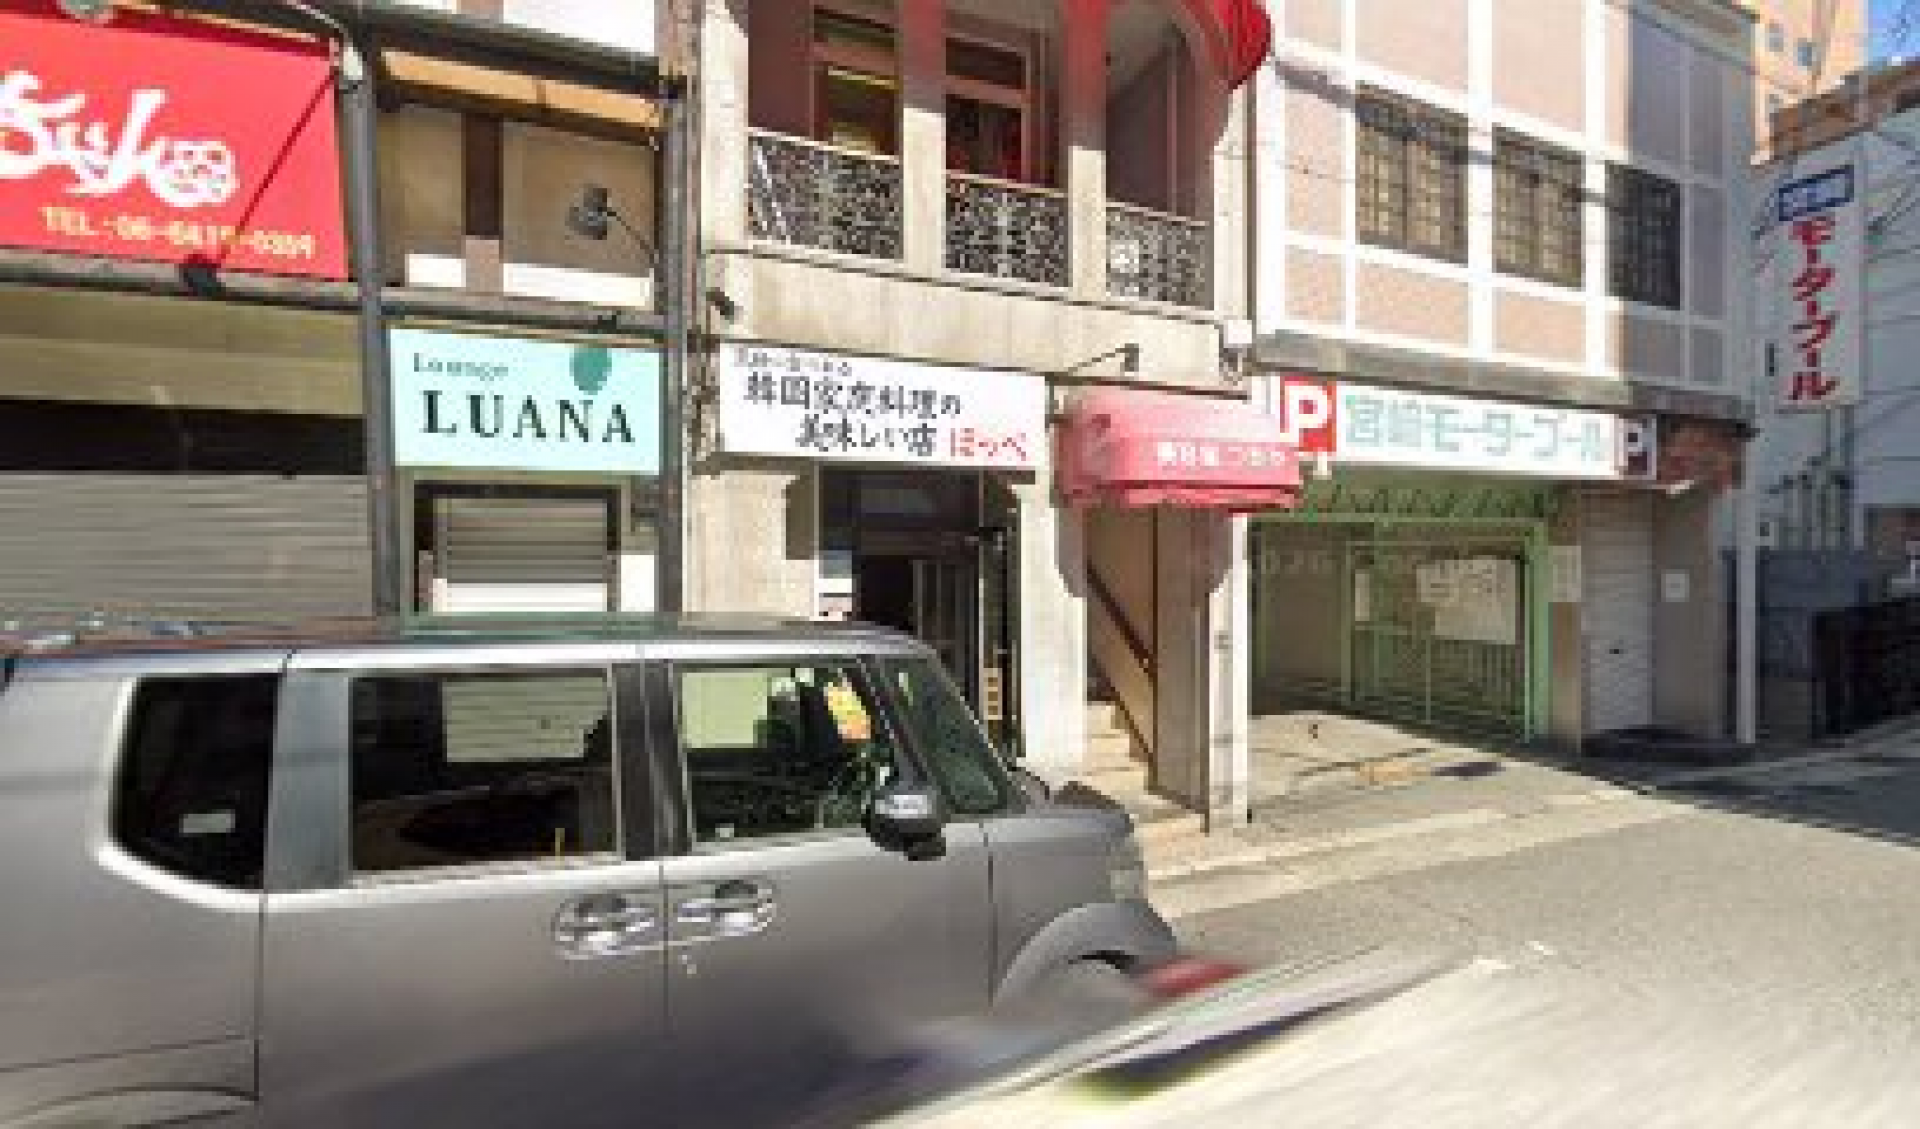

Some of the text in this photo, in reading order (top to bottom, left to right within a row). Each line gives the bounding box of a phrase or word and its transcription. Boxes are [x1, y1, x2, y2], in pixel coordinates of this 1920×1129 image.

[413, 352, 510, 382] Lounge
[419, 390, 637, 442] LUANA
[743, 371, 961, 420] 韓国家庭料理の
[1284, 386, 1327, 443] P
[795, 413, 937, 457] 美味しい店
[1618, 420, 1646, 468] P
